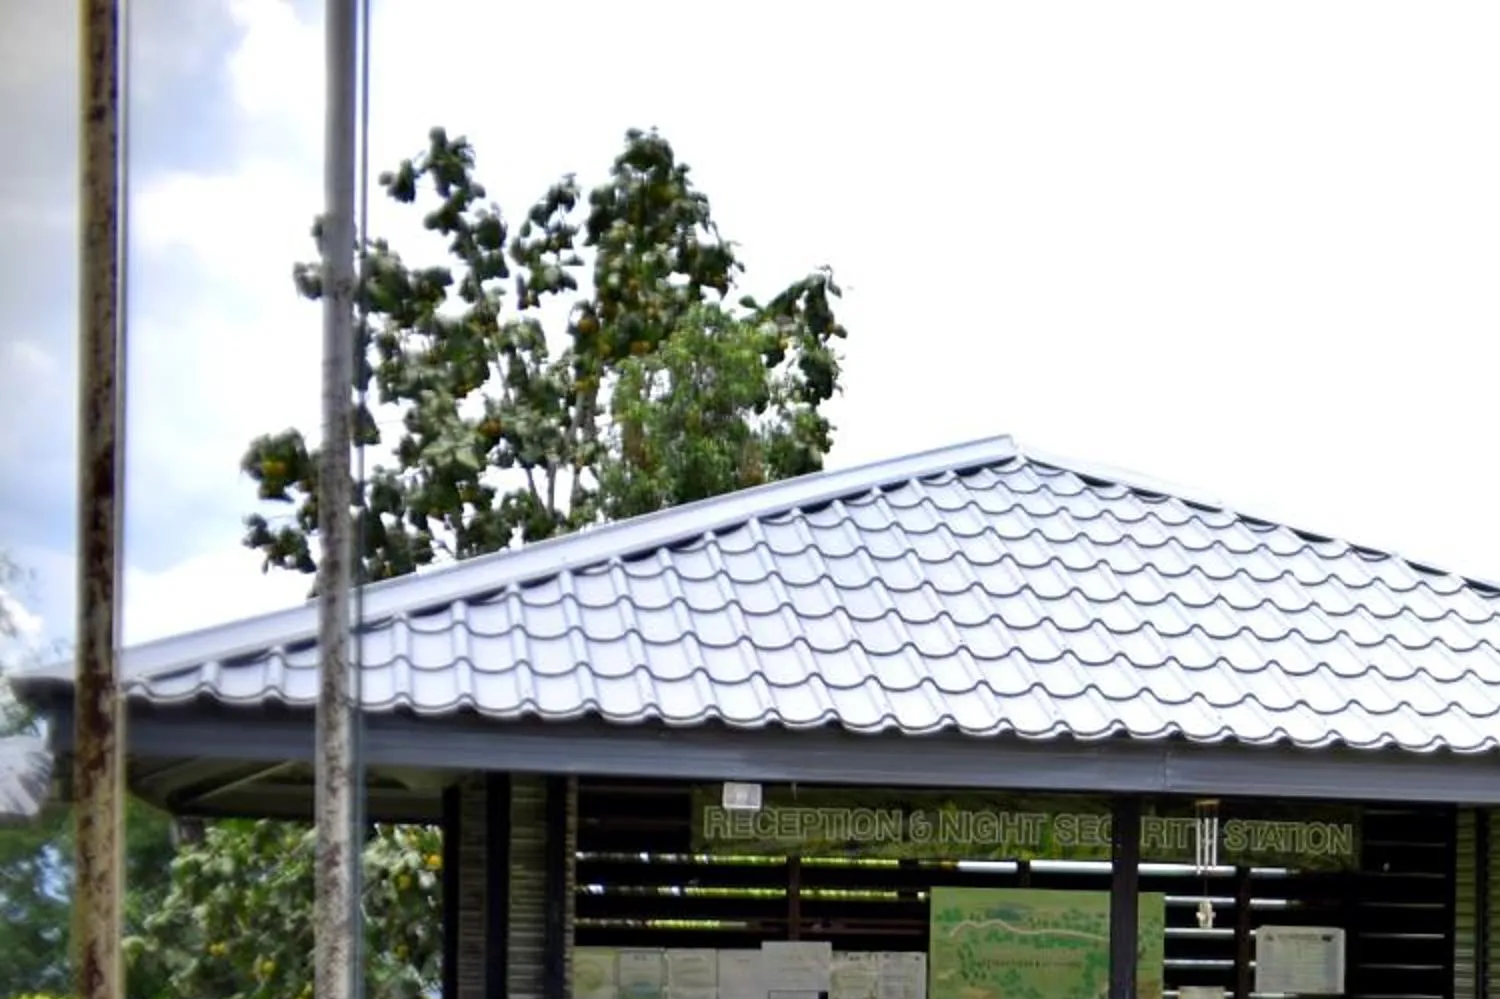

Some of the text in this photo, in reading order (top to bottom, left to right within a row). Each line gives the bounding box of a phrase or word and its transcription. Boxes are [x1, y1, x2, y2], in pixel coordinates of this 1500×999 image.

[703, 805, 1352, 855] RECEPTION & NIGHT SECRIT STATION
